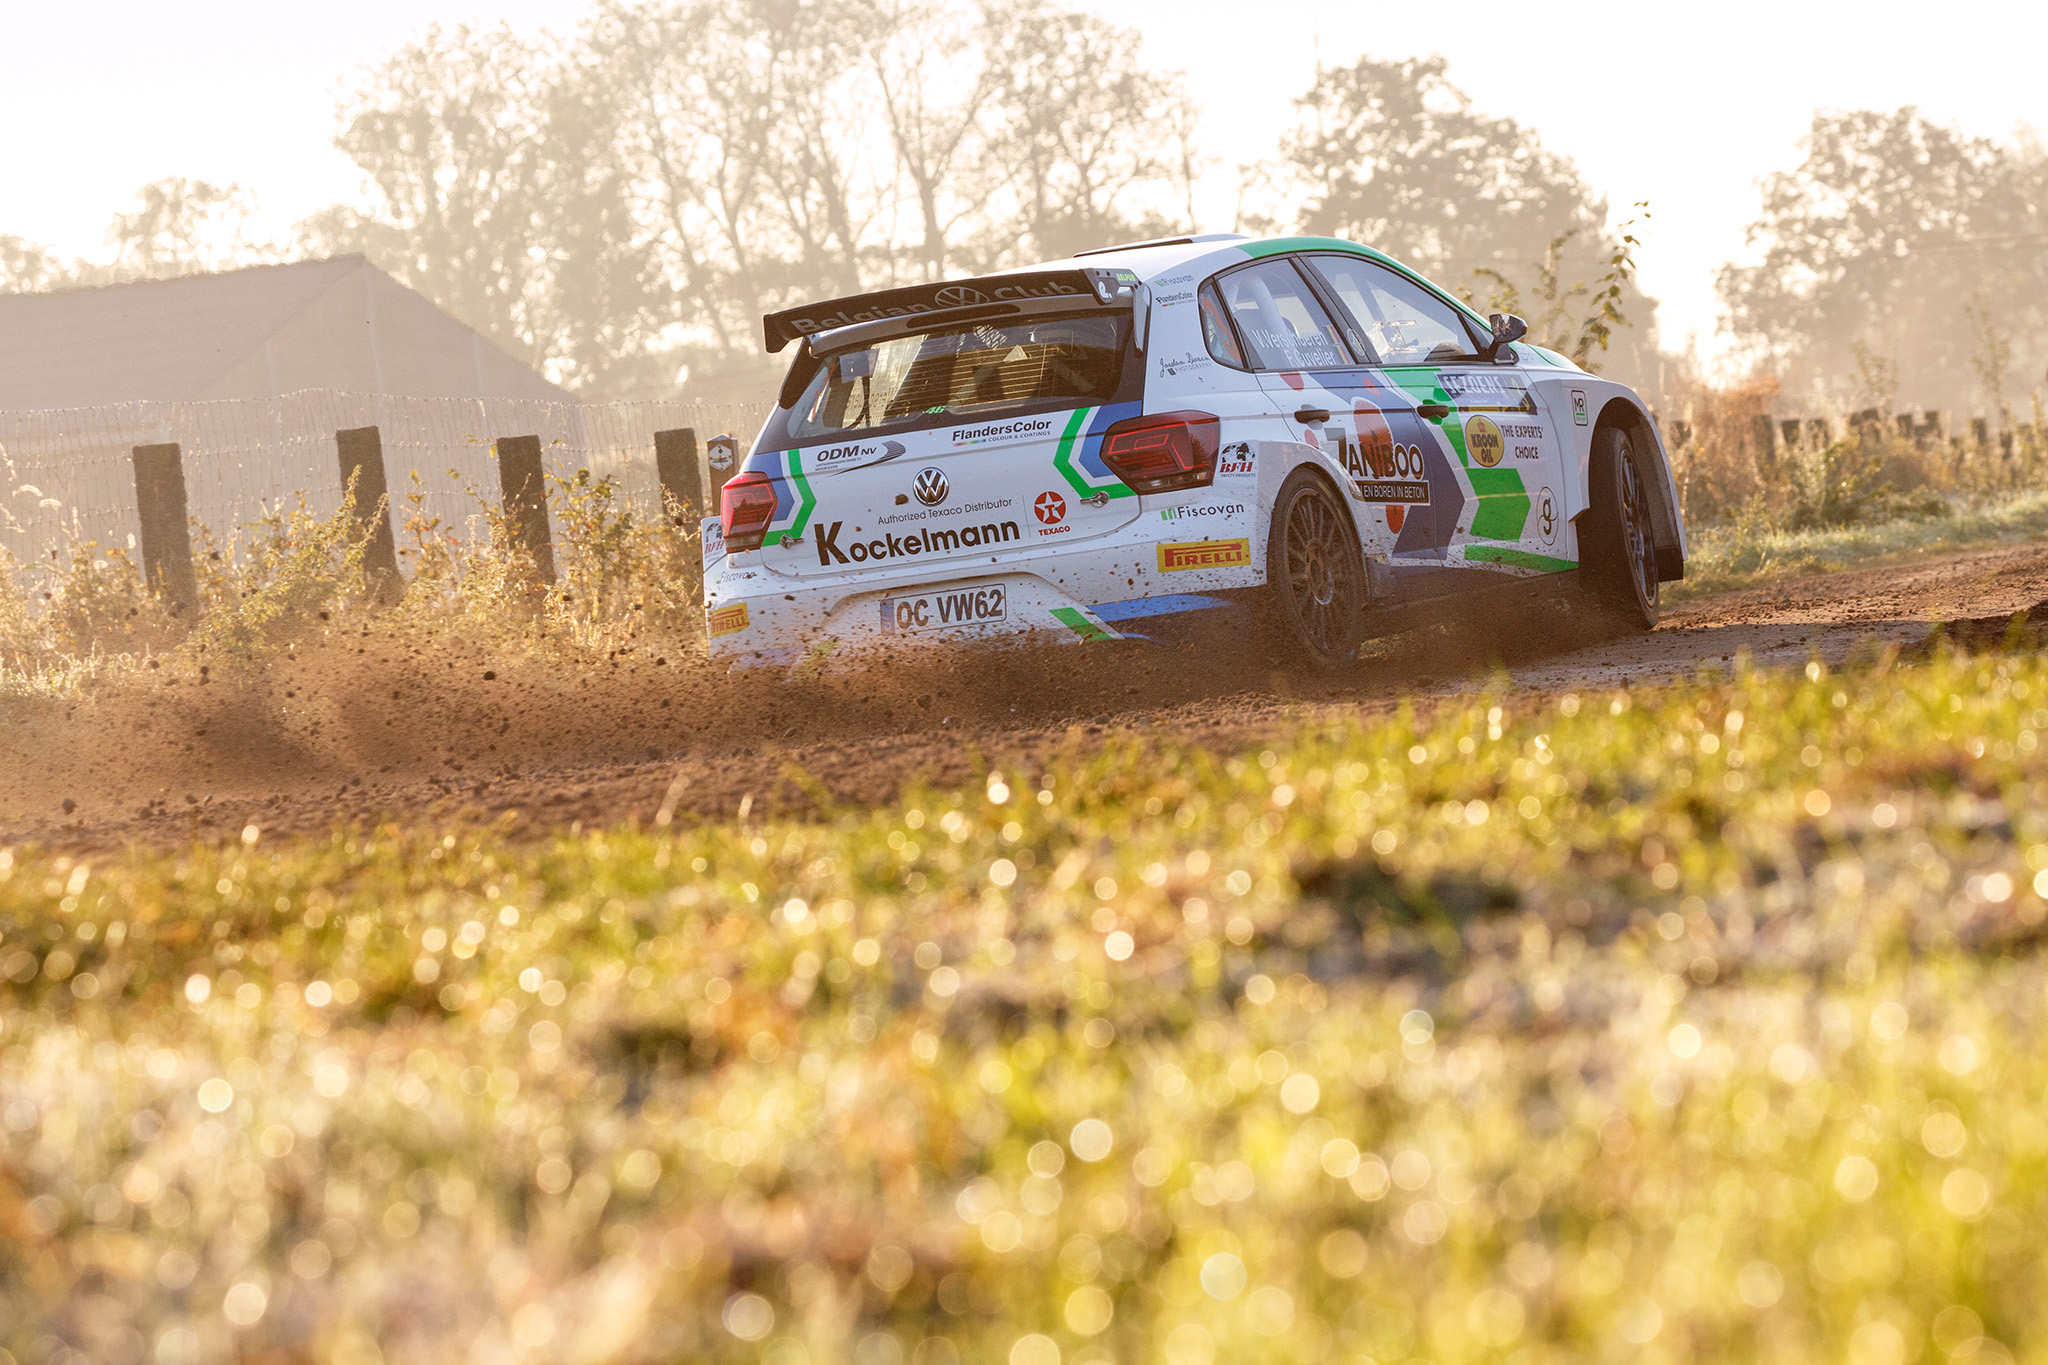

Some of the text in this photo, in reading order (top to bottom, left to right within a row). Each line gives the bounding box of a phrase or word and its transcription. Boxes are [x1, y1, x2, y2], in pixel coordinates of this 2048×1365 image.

[791, 303, 932, 334] Belgian
[994, 282, 1078, 300] Club
[1574, 397, 1585, 412] MR
[952, 420, 1051, 441] FlandersColor
[1501, 425, 1514, 437] THE
[988, 435, 1013, 443] COLOUR
[1471, 434, 1499, 448] KROON
[817, 445, 877, 462] ODM NV
[1481, 448, 1494, 463] OIL
[1515, 446, 1539, 459] CHOICE
[1220, 462, 1253, 473] BFH
[1364, 485, 1373, 497] EN
[1374, 486, 1397, 498] BOREN
[1397, 486, 1404, 498] IN
[1404, 487, 1425, 498] BETON
[877, 498, 1013, 526] Authorized Texaco Distributor
[1177, 503, 1245, 519] Fiscovan
[1038, 525, 1071, 537] TEXACO
[814, 520, 1021, 566] Kockelmann
[1164, 543, 1242, 567] PIRELLI
[896, 589, 1003, 629] OC VW62
[711, 608, 746, 633] PIRELLI
